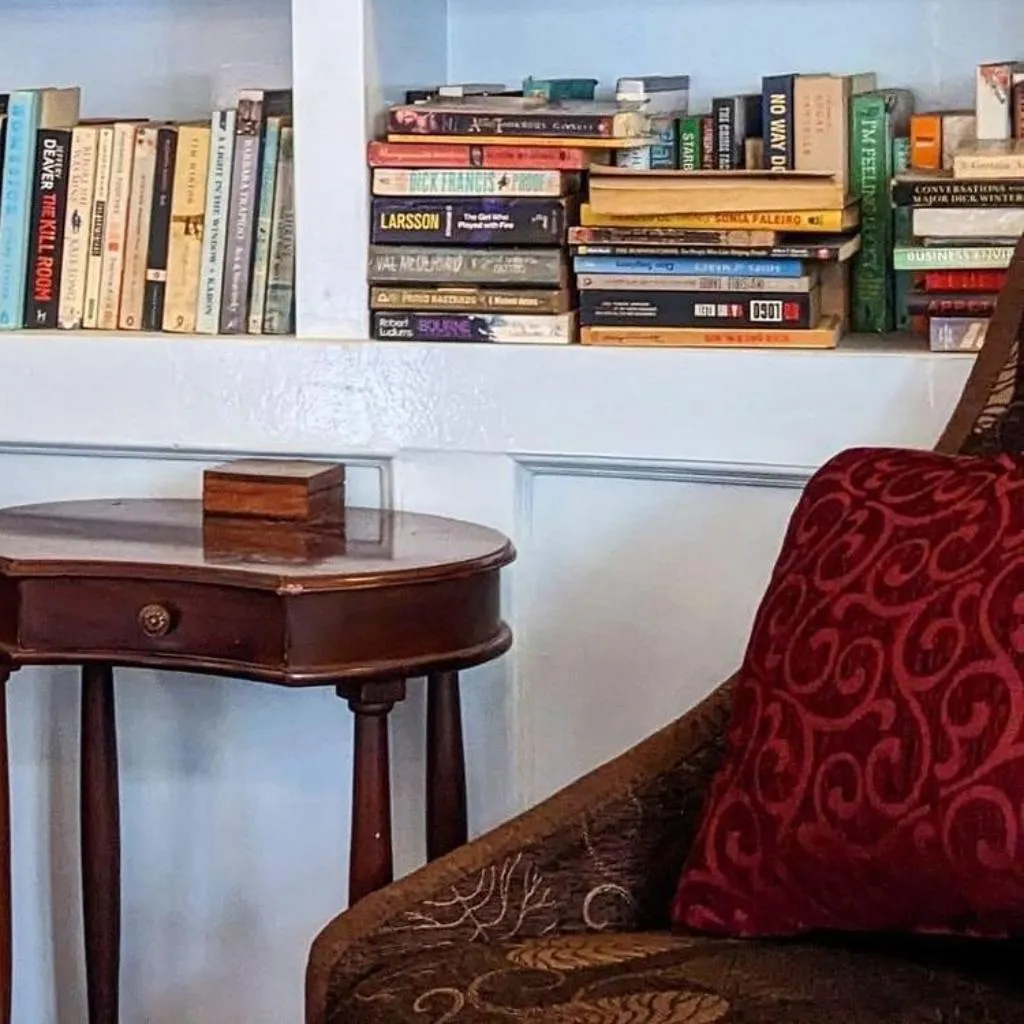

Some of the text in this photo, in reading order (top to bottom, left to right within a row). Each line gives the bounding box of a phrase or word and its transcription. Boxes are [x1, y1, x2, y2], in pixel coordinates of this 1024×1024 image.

[769, 94, 787, 152] NO WAY
[40, 139, 56, 190] DEAVER
[55, 145, 64, 179] JEFFERY
[215, 145, 225, 177] LIGHT
[240, 139, 253, 190] BARBARA
[215, 180, 223, 194] IN
[914, 185, 1006, 194] CONVERSATIONS
[979, 194, 1024, 202] WINTER
[212, 195, 223, 214] THE
[380, 213, 440, 230] LARSSON
[752, 214, 801, 226] FALEIRO
[34, 194, 57, 301] THE KILL ROOM
[209, 219, 220, 263] WINDOW
[906, 250, 966, 260] BUSINESS
[205, 276, 216, 316] KARON
[752, 302, 781, 320] LOGO
